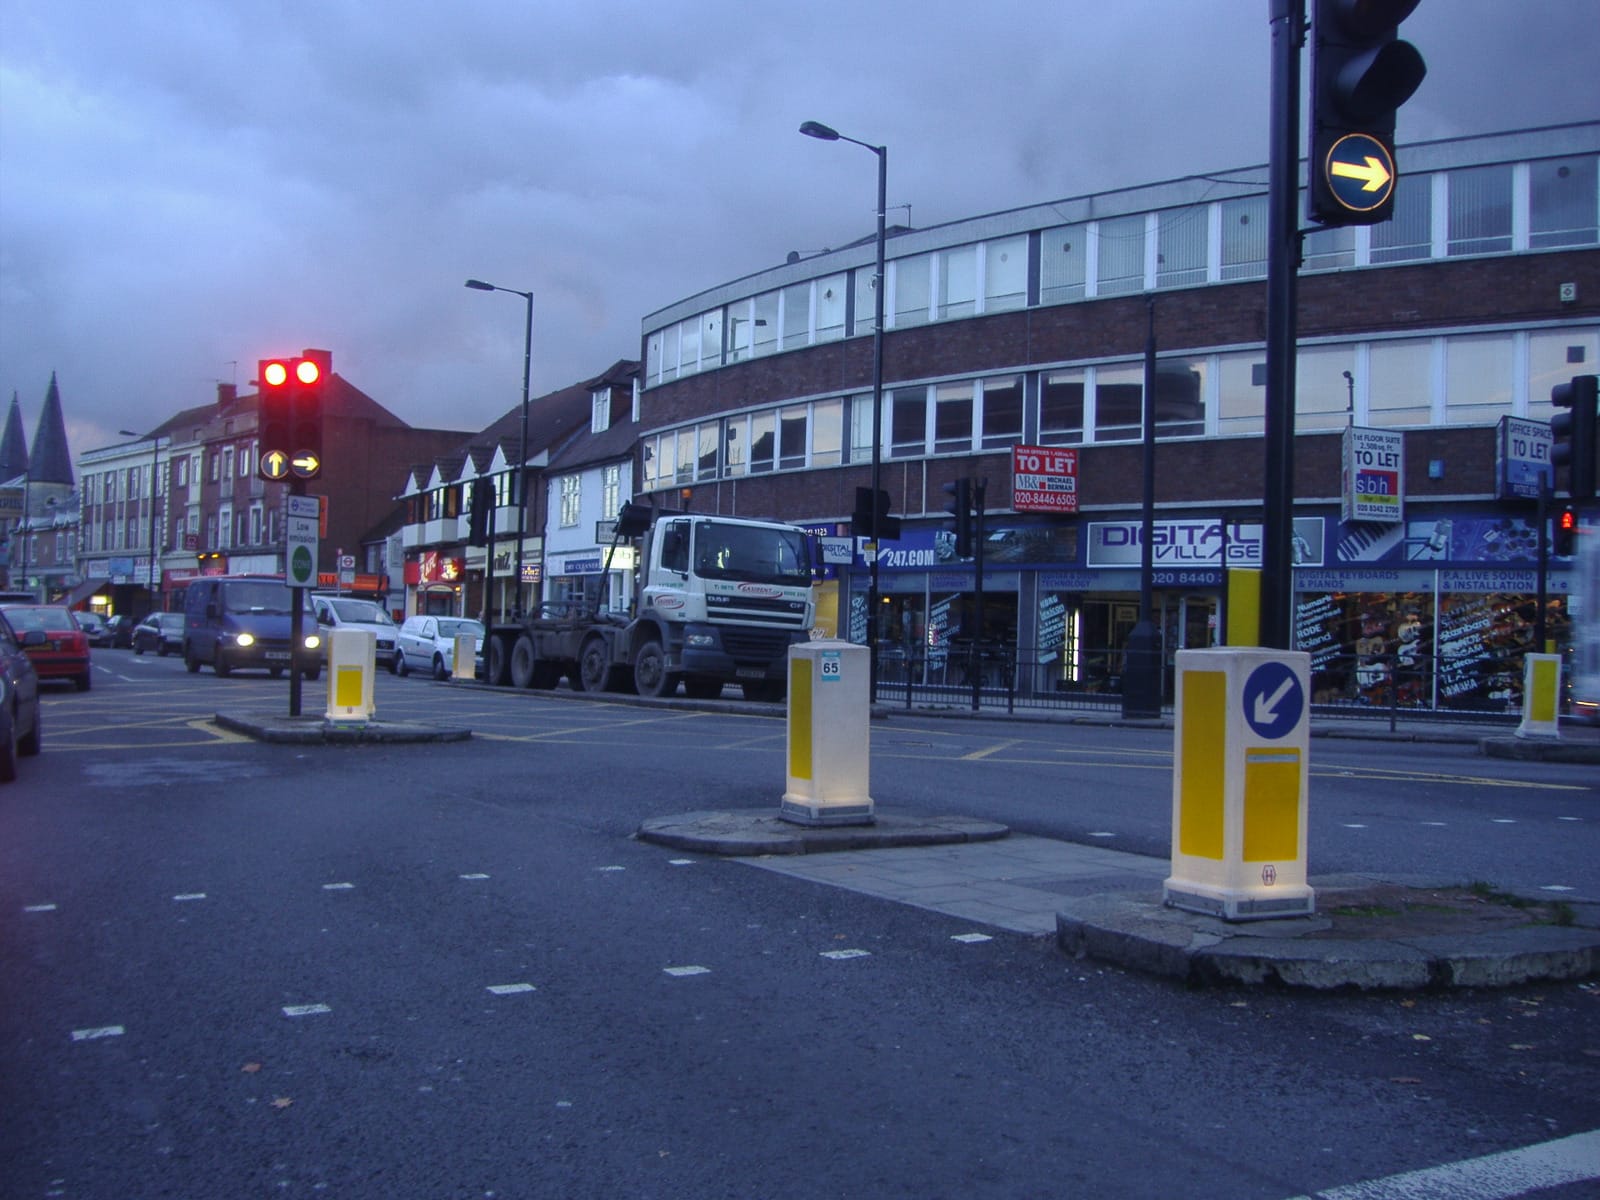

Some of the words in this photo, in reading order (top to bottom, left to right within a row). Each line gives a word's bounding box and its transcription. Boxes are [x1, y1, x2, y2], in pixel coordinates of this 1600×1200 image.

[1509, 422, 1531, 437] OFFICE
[1532, 426, 1552, 440] SPACE
[1364, 434, 1384, 442] FLOOR
[1513, 439, 1527, 457] TO
[1531, 441, 1548, 460] LET
[1017, 455, 1040, 472] TO
[1045, 457, 1075, 473] LET
[1354, 450, 1373, 466] TO
[1378, 452, 1399, 468] LET
[1047, 476, 1073, 484] MICHAEL
[1015, 491, 1055, 505] 020-8446
[1056, 494, 1077, 506] 6505
[296, 520, 309, 531] Low
[289, 534, 317, 544] emission
[1102, 525, 1260, 546] DIGITAL
[1155, 545, 1260, 559] VILLAGE
[1179, 572, 1215, 584] 8440
[1299, 570, 1336, 580] DIGITAL
[1340, 570, 1400, 580] KEYBOARDS
[1468, 570, 1489, 581] LIVE
[1308, 580, 1345, 588] PIANOS
[1443, 581, 1450, 590] &
[1454, 581, 1534, 590] INSTALLATION
[1297, 595, 1332, 613] Numark
[1297, 631, 1333, 650] Roland
[823, 662, 839, 674] 65
